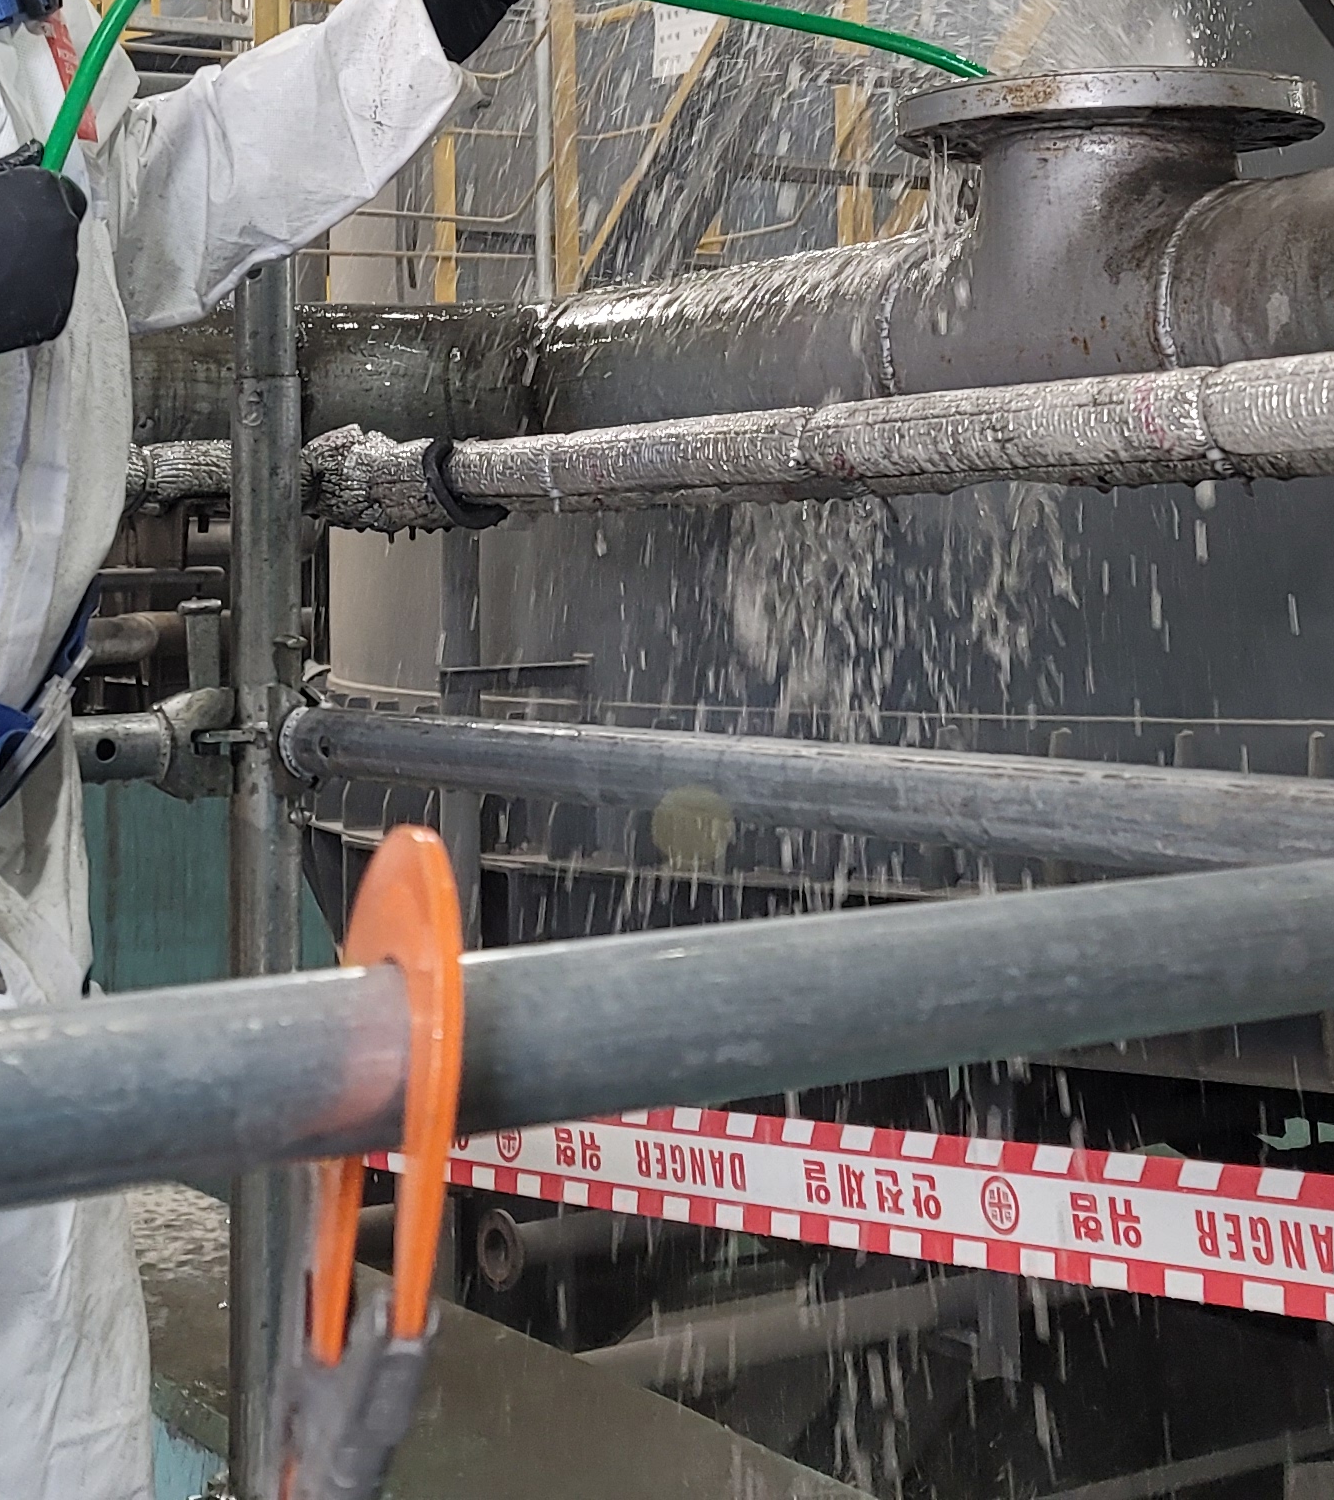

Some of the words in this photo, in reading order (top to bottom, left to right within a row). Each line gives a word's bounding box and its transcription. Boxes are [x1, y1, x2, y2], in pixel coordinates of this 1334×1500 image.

[554, 1127, 602, 1171] 위험
[635, 1140, 747, 1191] DANGER
[803, 1159, 942, 1220] 안전제일
[1069, 1192, 1142, 1249] 위험
